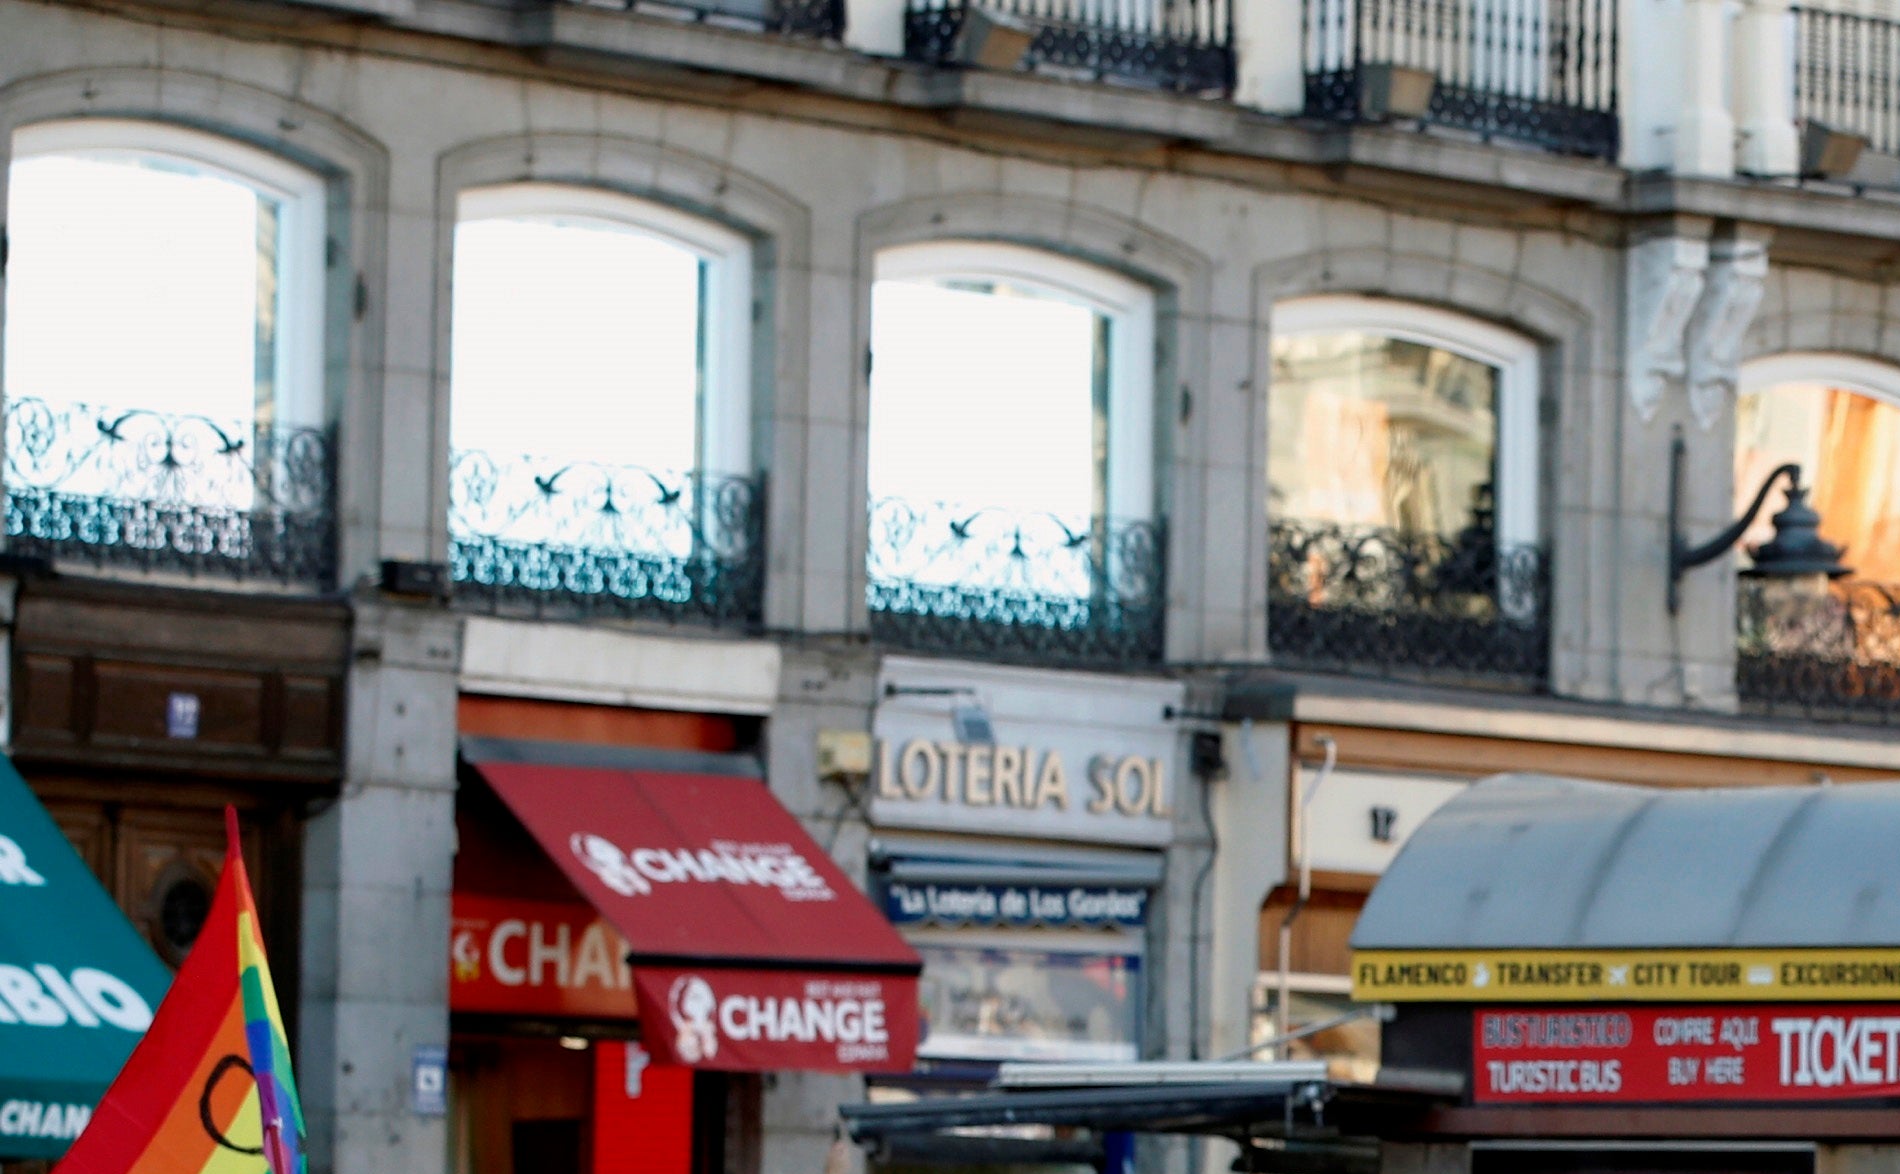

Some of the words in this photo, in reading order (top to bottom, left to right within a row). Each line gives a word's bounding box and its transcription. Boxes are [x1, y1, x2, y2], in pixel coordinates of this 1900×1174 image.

[876, 739, 1066, 811] LOTERIA
[1086, 754, 1173, 816] SOL
[631, 847, 824, 891] CHANGE
[1000, 888, 1025, 915] de
[1029, 890, 1066, 918] Los
[1358, 962, 1467, 987] FLAMENCO
[1496, 962, 1604, 987] TRANSFER
[1633, 962, 1679, 987] CITY
[1689, 962, 1742, 987] TOUR
[0, 962, 154, 1033] BIO
[720, 993, 889, 1042] CHANGE
[1482, 1013, 1527, 1047] BUS
[1653, 1017, 1714, 1046] COMPRE
[1487, 1060, 1579, 1093] TURISTIC
[1581, 1060, 1622, 1093] BUS
[1667, 1057, 1699, 1085] BUY
[1705, 1057, 1745, 1085] HERE
